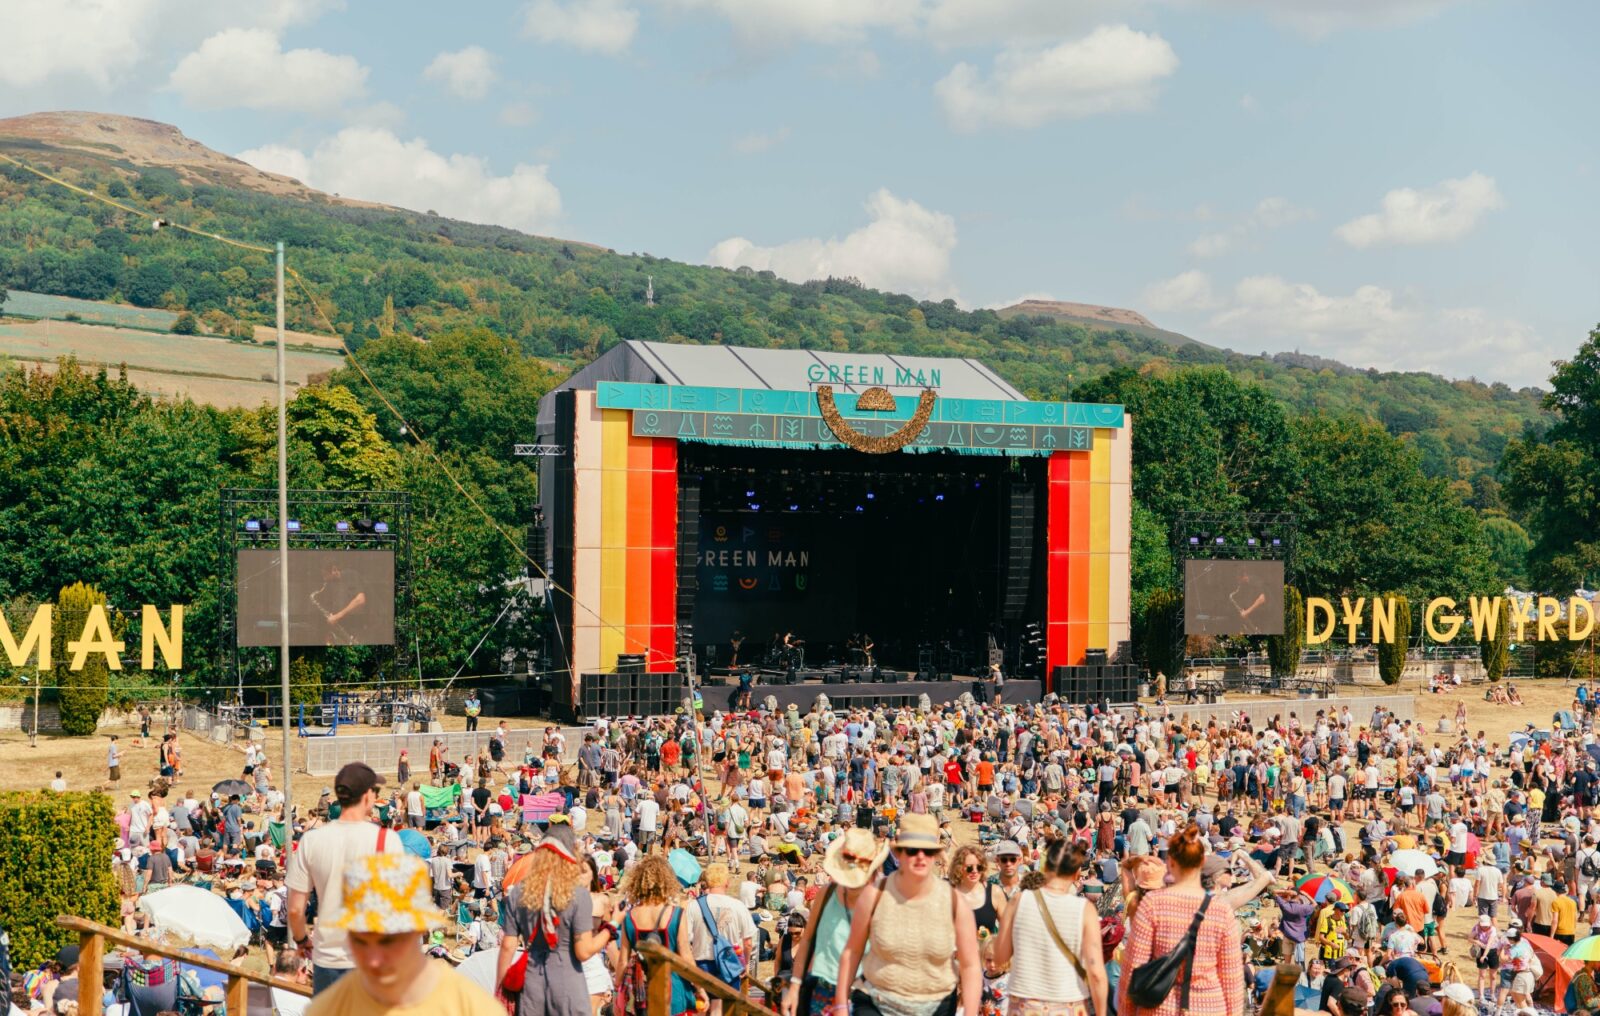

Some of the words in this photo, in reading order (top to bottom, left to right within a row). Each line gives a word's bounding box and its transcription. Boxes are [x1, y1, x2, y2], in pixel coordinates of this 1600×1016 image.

[807, 363, 884, 385] GREEN
[895, 367, 941, 386] MAN
[768, 550, 809, 567] MAN
[0, 603, 184, 671] MAN
[1306, 597, 1396, 644] DYN
[1425, 596, 1595, 643] GWYRD
